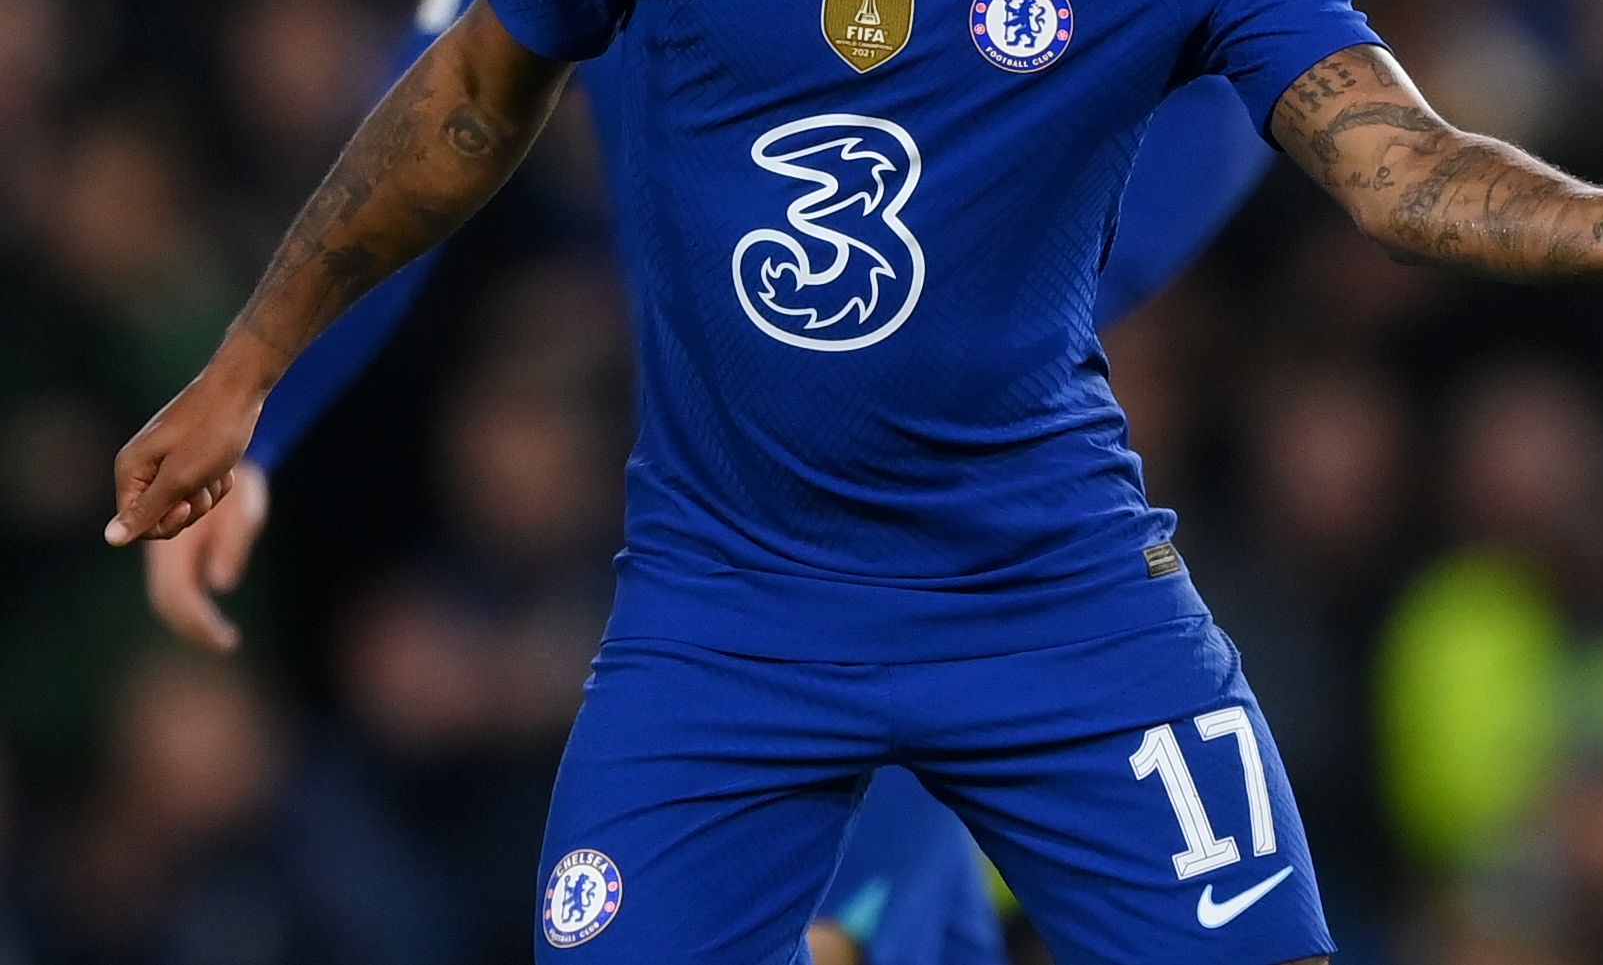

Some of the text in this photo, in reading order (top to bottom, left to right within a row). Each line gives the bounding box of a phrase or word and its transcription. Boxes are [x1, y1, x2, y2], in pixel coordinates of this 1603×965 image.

[846, 25, 885, 44] FIFA
[851, 47, 875, 58] 2021
[985, 46, 1054, 68] FOOTBALL CLUB
[731, 113, 926, 352] 3
[1128, 706, 1277, 881] 17
[556, 852, 609, 877] CHELSEA
